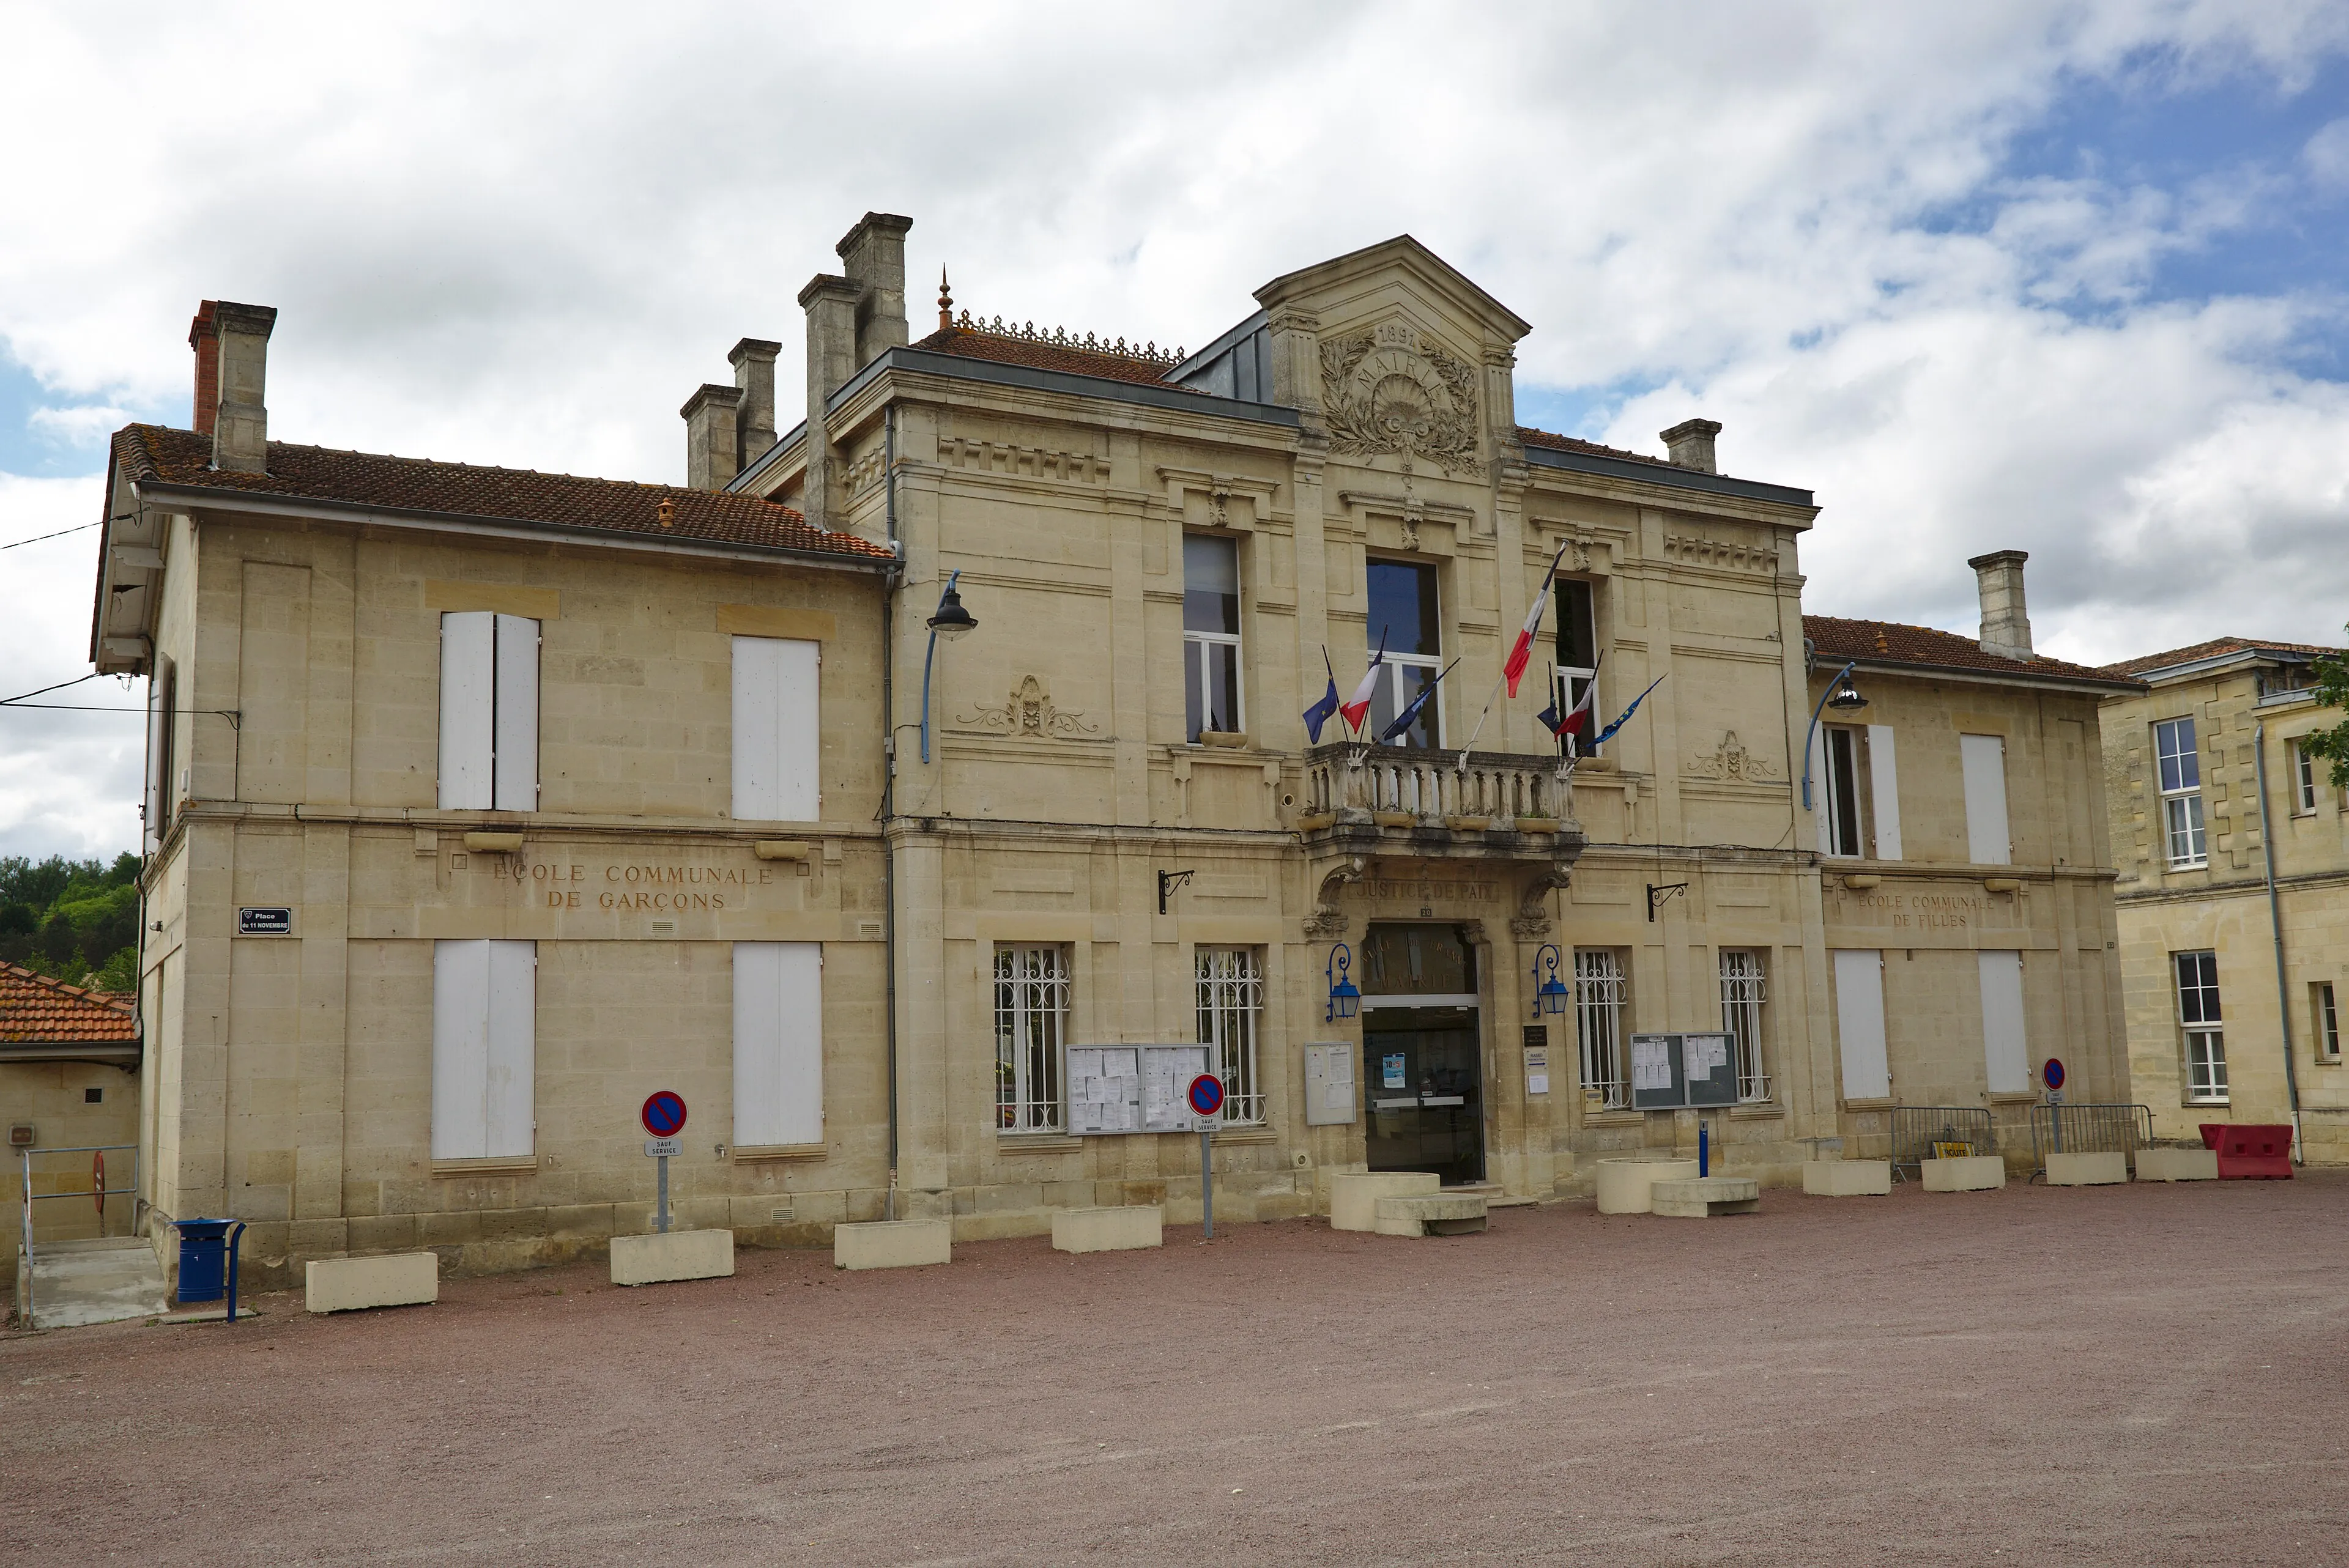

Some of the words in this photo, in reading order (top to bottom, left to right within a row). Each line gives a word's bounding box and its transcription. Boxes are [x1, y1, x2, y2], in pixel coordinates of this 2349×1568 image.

[1379, 325, 1416, 347] 1891
[1357, 352, 1444, 401] MAIRIE
[494, 863, 585, 881] ECOLE
[606, 866, 773, 885] COMMUNALE
[1356, 882, 1429, 898] JUSTICE
[1433, 884, 1454, 898] DE
[1460, 884, 1492, 900] PAIX
[548, 891, 582, 908] DE
[599, 892, 724, 912] GARÇONS
[1858, 895, 1903, 908] ECOLE
[1912, 896, 1994, 910] COMMUNALE
[1893, 914, 1910, 926] DE
[1918, 915, 1966, 928] FILLES
[1379, 974, 1450, 989] MAIRIE
